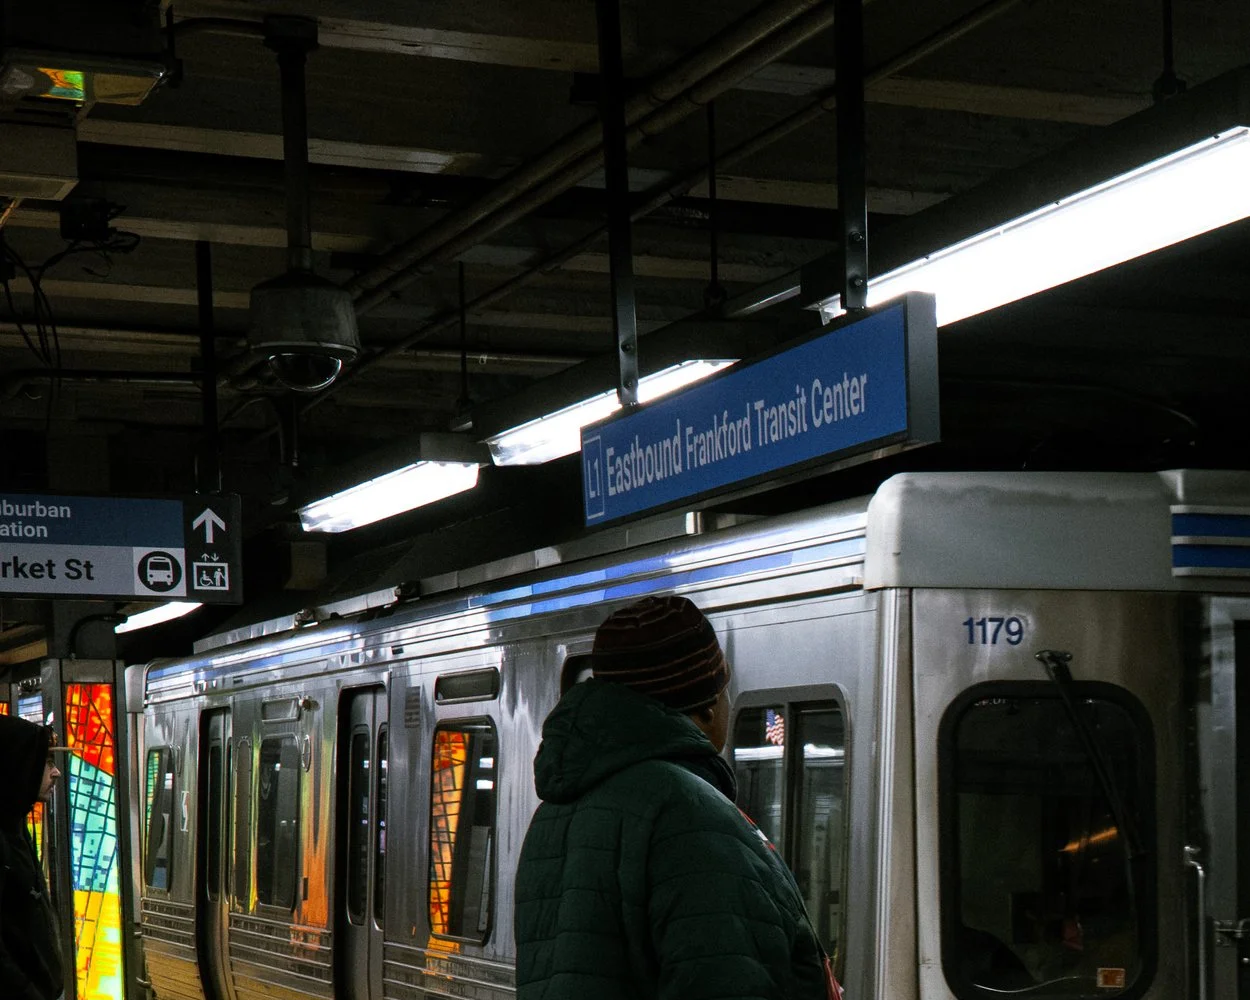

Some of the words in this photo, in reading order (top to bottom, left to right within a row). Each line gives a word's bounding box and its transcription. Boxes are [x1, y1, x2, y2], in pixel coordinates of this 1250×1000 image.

[588, 458, 600, 499] L1
[606, 418, 682, 497] Eastbound
[685, 402, 752, 471] Frankford
[754, 384, 808, 447] Transit
[811, 371, 867, 429] Center
[0, 499, 71, 518] burban
[2, 556, 57, 580] rket
[64, 558, 95, 581] St
[962, 616, 1024, 646] 1179
